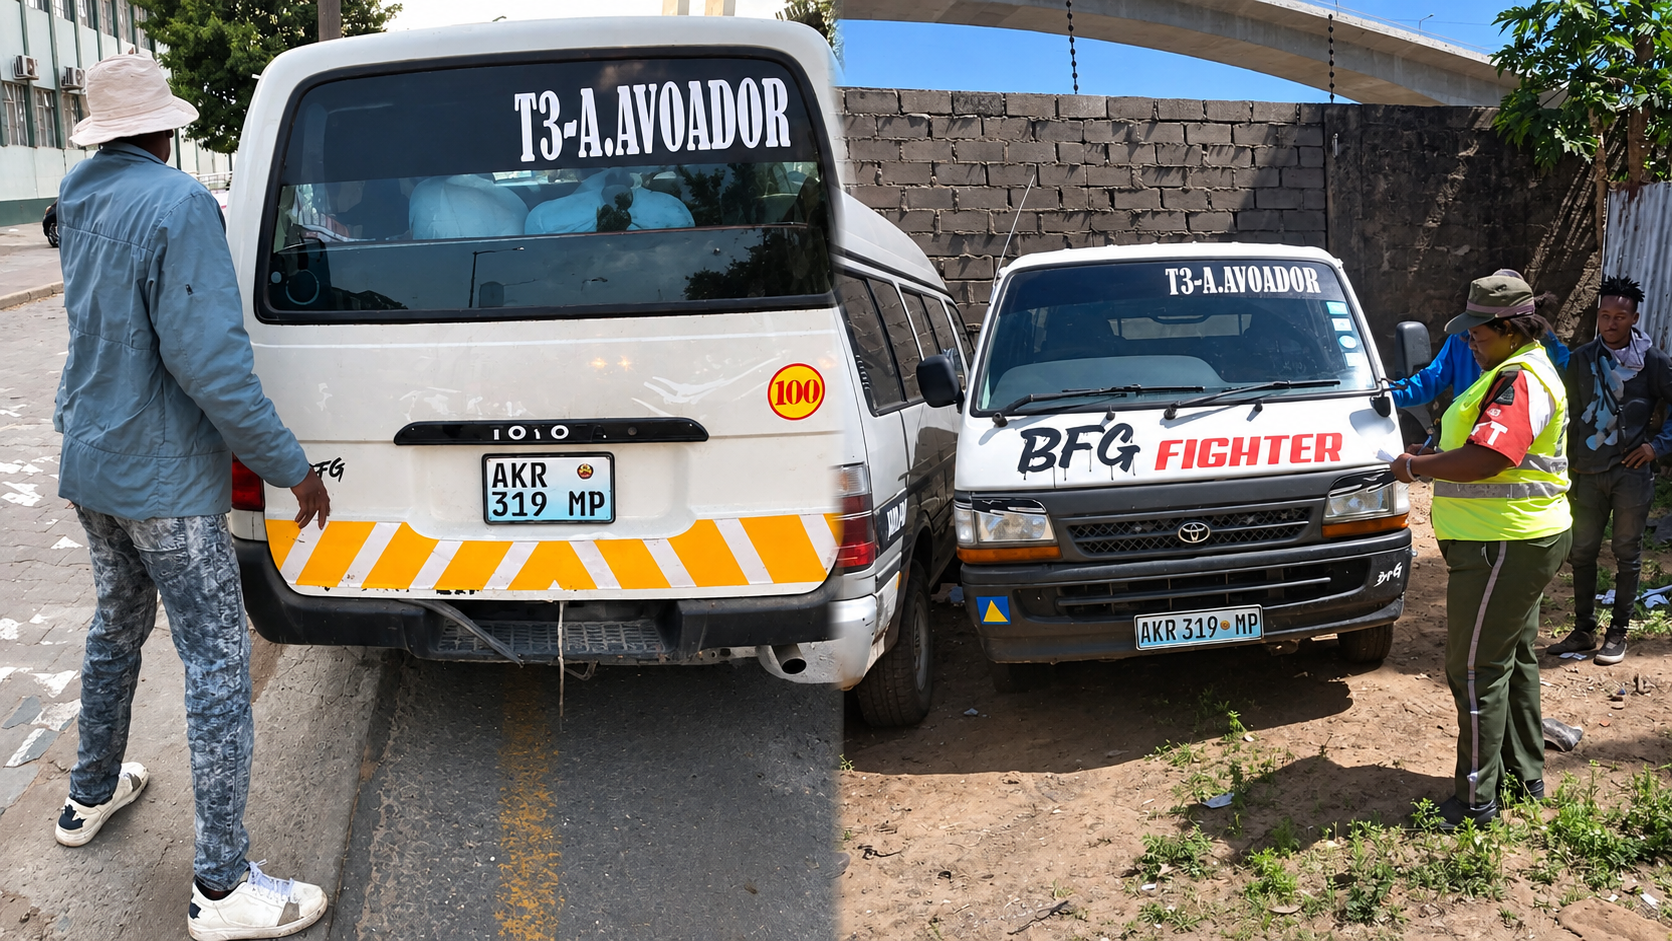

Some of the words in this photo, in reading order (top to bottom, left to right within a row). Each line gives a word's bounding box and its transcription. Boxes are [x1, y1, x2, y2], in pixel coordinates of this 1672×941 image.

[514, 77, 791, 162] T3-A.AVOADOR
[1165, 265, 1321, 295] T3-A.AVOADOR
[775, 379, 820, 406] 100
[1017, 423, 1141, 480] BFG
[1155, 432, 1342, 470] FIGHTER
[309, 457, 345, 482] FG
[491, 462, 548, 488] AKR
[491, 491, 548, 517] 319
[568, 491, 605, 516] MP
[1141, 619, 1177, 643] AKR
[1182, 616, 1218, 640] 319
[1235, 613, 1258, 635] MP
